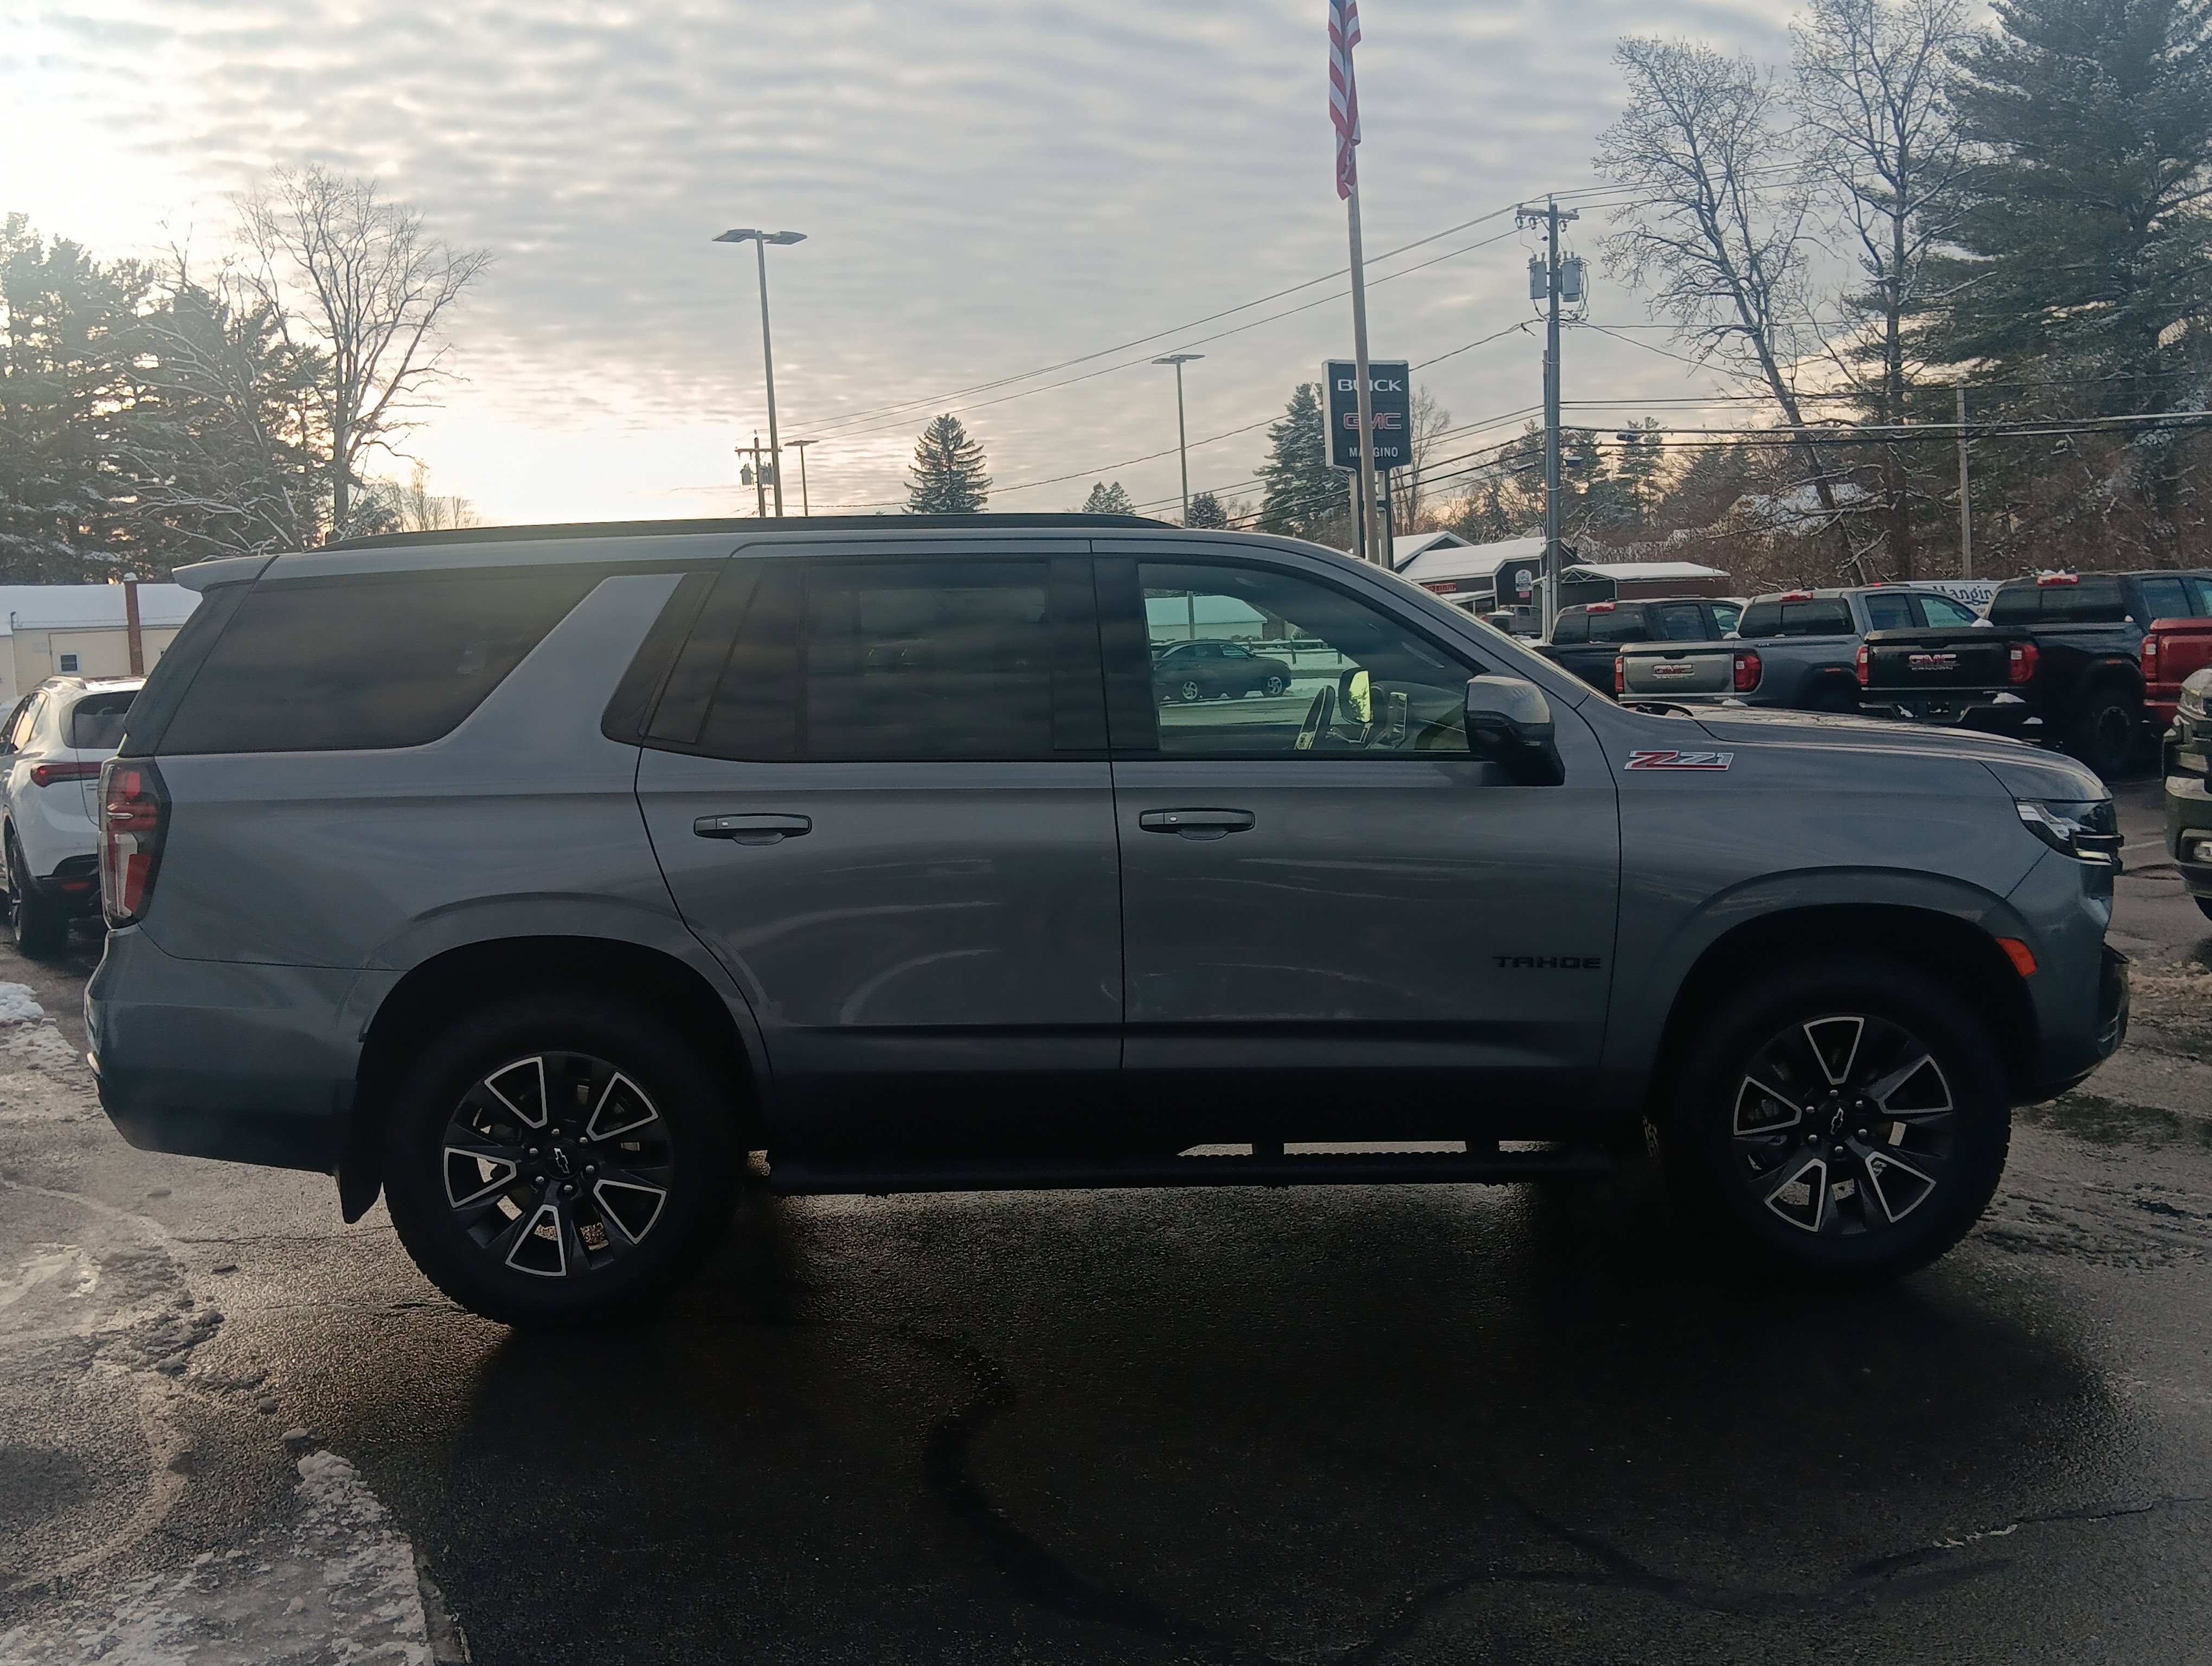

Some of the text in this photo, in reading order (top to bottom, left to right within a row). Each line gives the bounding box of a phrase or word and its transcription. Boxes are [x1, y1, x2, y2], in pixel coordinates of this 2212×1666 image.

[1338, 379, 1402, 392] BICK
[1349, 447, 1398, 458] MGINO
[1624, 750, 1734, 771] Z71
[1492, 956, 1602, 969] TAHOE
